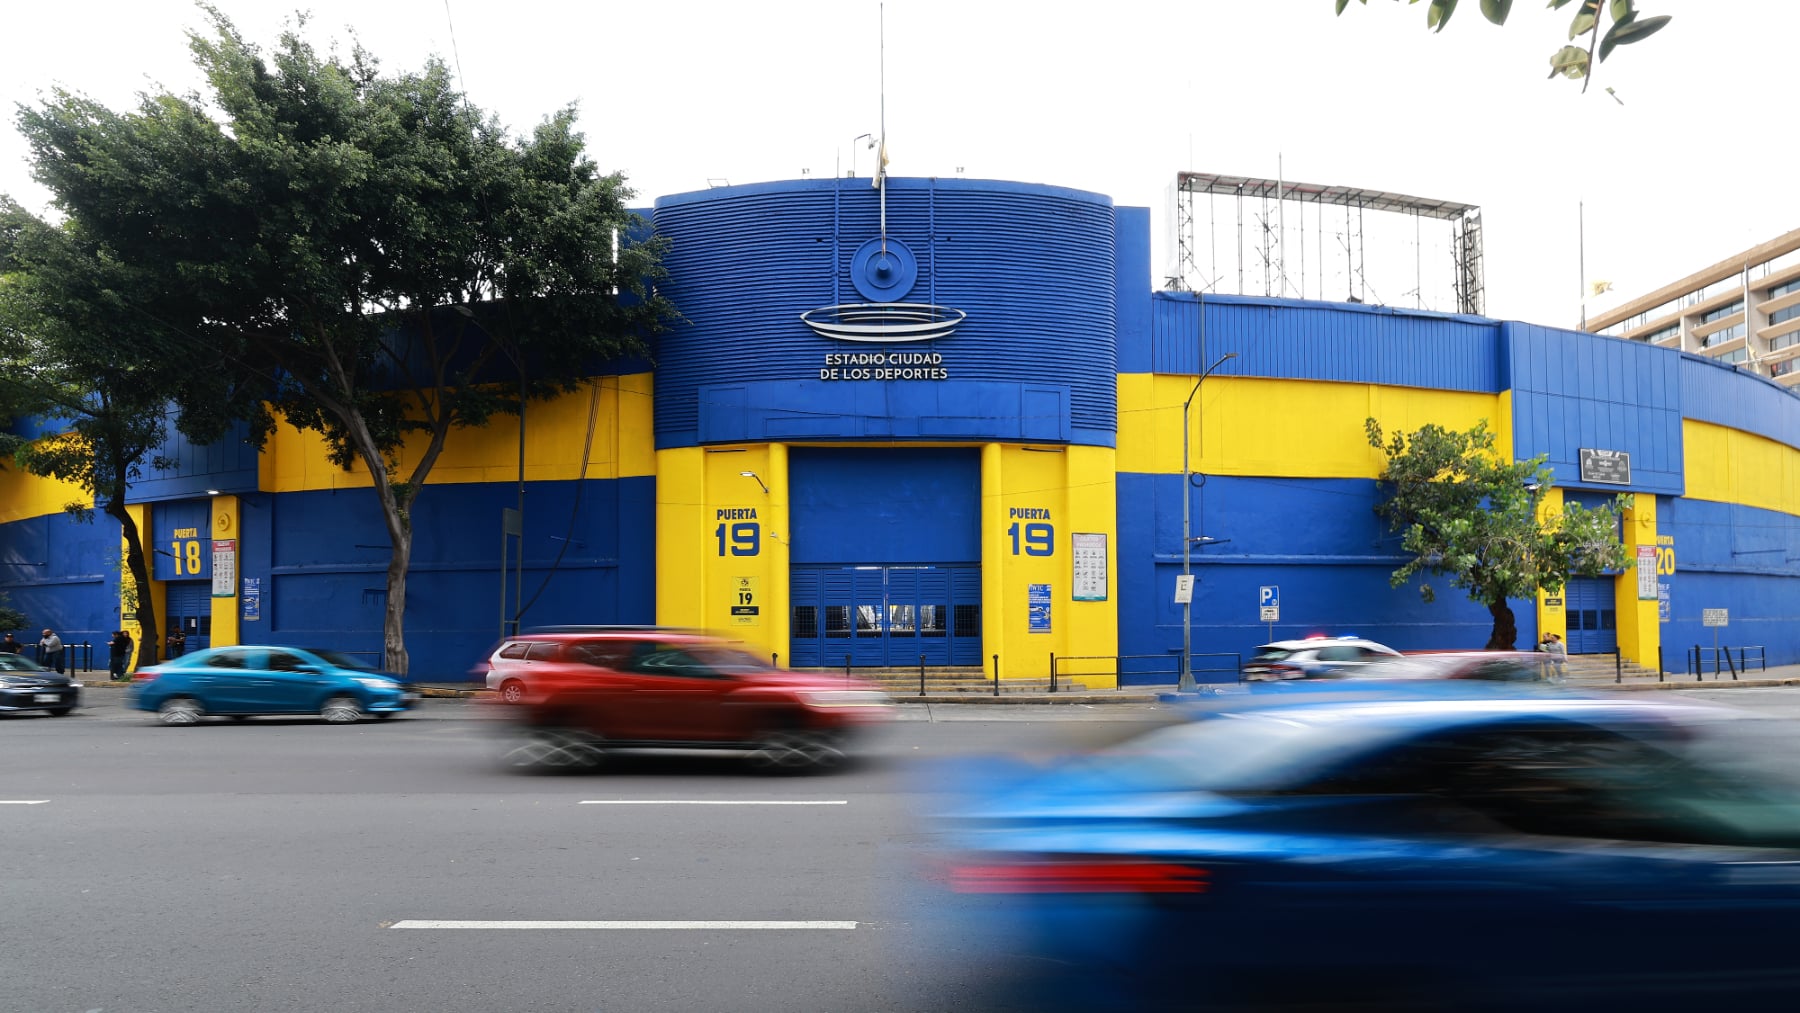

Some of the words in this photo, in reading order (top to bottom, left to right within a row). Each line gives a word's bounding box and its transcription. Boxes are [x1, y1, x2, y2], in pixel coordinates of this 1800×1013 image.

[825, 353, 885, 365] ESTADIO
[889, 353, 942, 365] CIUDAD
[820, 368, 838, 380] DE
[843, 368, 871, 380] LOS
[875, 368, 948, 380] DEPORTES
[716, 508, 758, 520] PUERTA
[1009, 507, 1051, 520] PUERTA
[174, 527, 198, 539] PUERTA
[715, 522, 760, 557] 19
[1007, 521, 1054, 557] 19
[172, 540, 201, 575] 18
[1656, 547, 1675, 576] 20
[738, 592, 753, 605] 19
[1262, 588, 1273, 604] P
